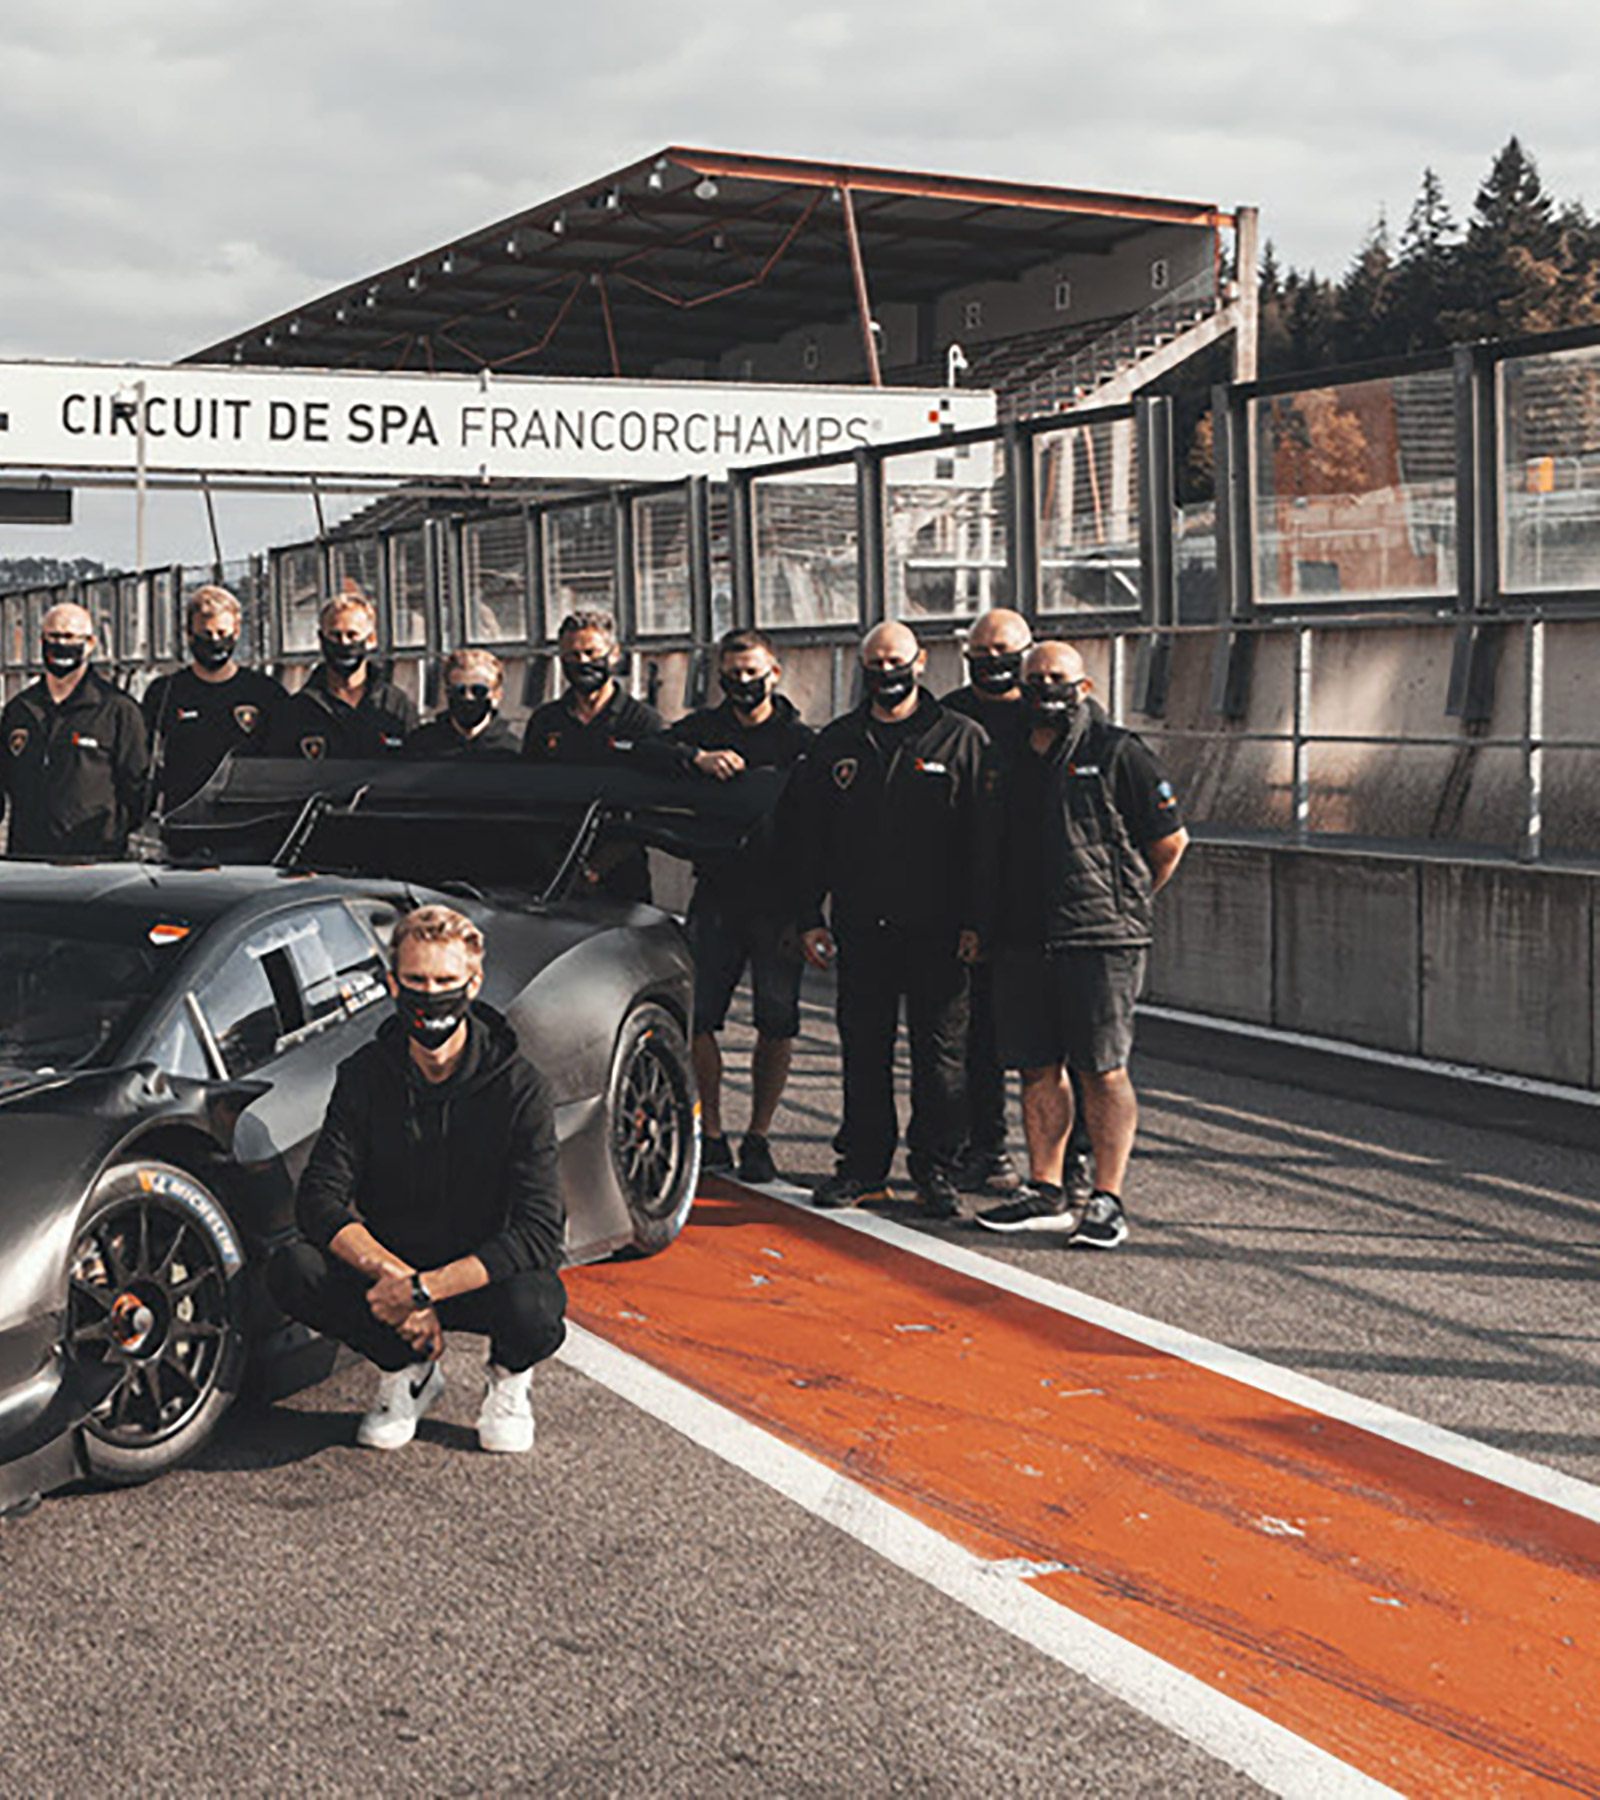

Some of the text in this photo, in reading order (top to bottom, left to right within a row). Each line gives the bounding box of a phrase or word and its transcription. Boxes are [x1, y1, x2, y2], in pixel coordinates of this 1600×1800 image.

[62, 393, 871, 455] CIRCUIT DE SPA FRANCORCHAMPS
[165, 1178, 237, 1257] MICHELIN
